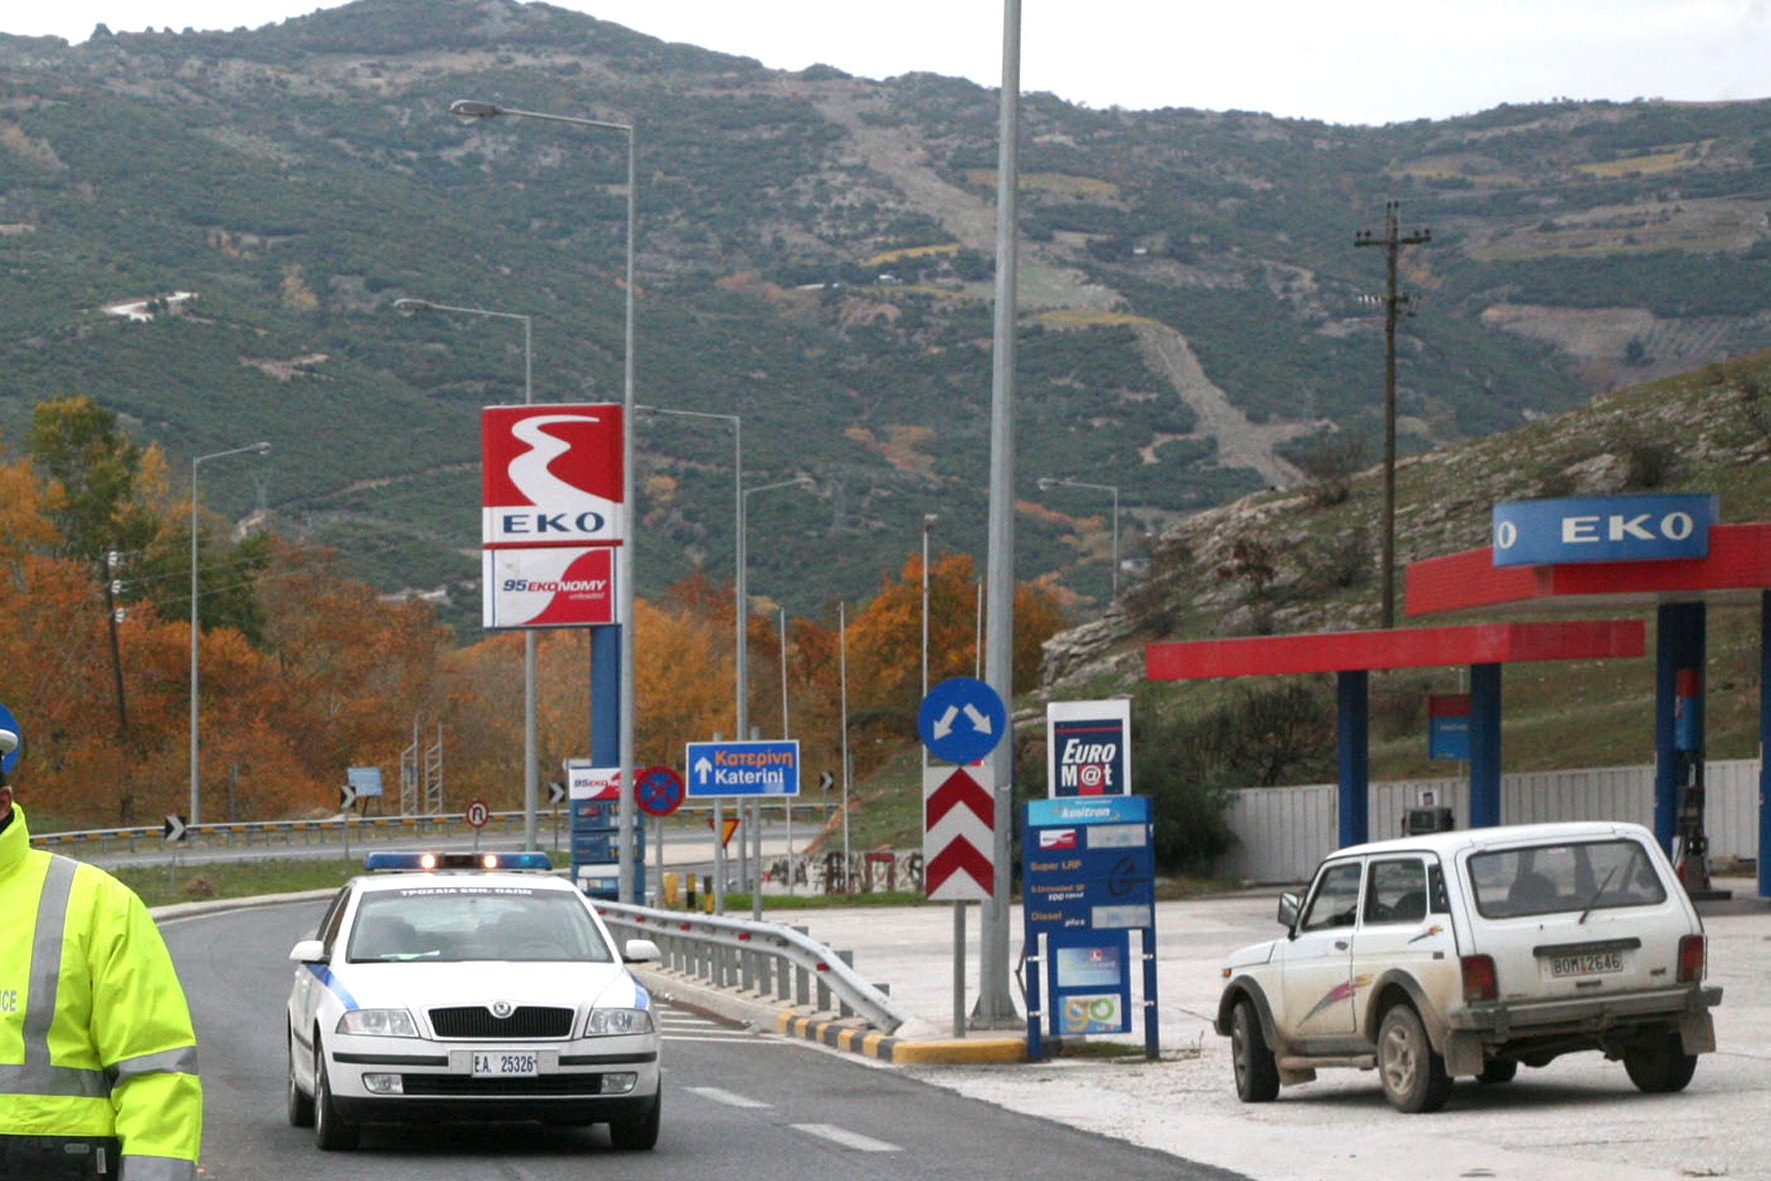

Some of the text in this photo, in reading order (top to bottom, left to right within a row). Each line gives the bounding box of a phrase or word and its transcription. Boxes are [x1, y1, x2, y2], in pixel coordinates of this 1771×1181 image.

[503, 511, 605, 533] EKO
[1561, 511, 1694, 543] EKO
[715, 748, 793, 768] Κατερίνη
[715, 768, 783, 784] Katerini
[501, 1055, 534, 1073] 25326
